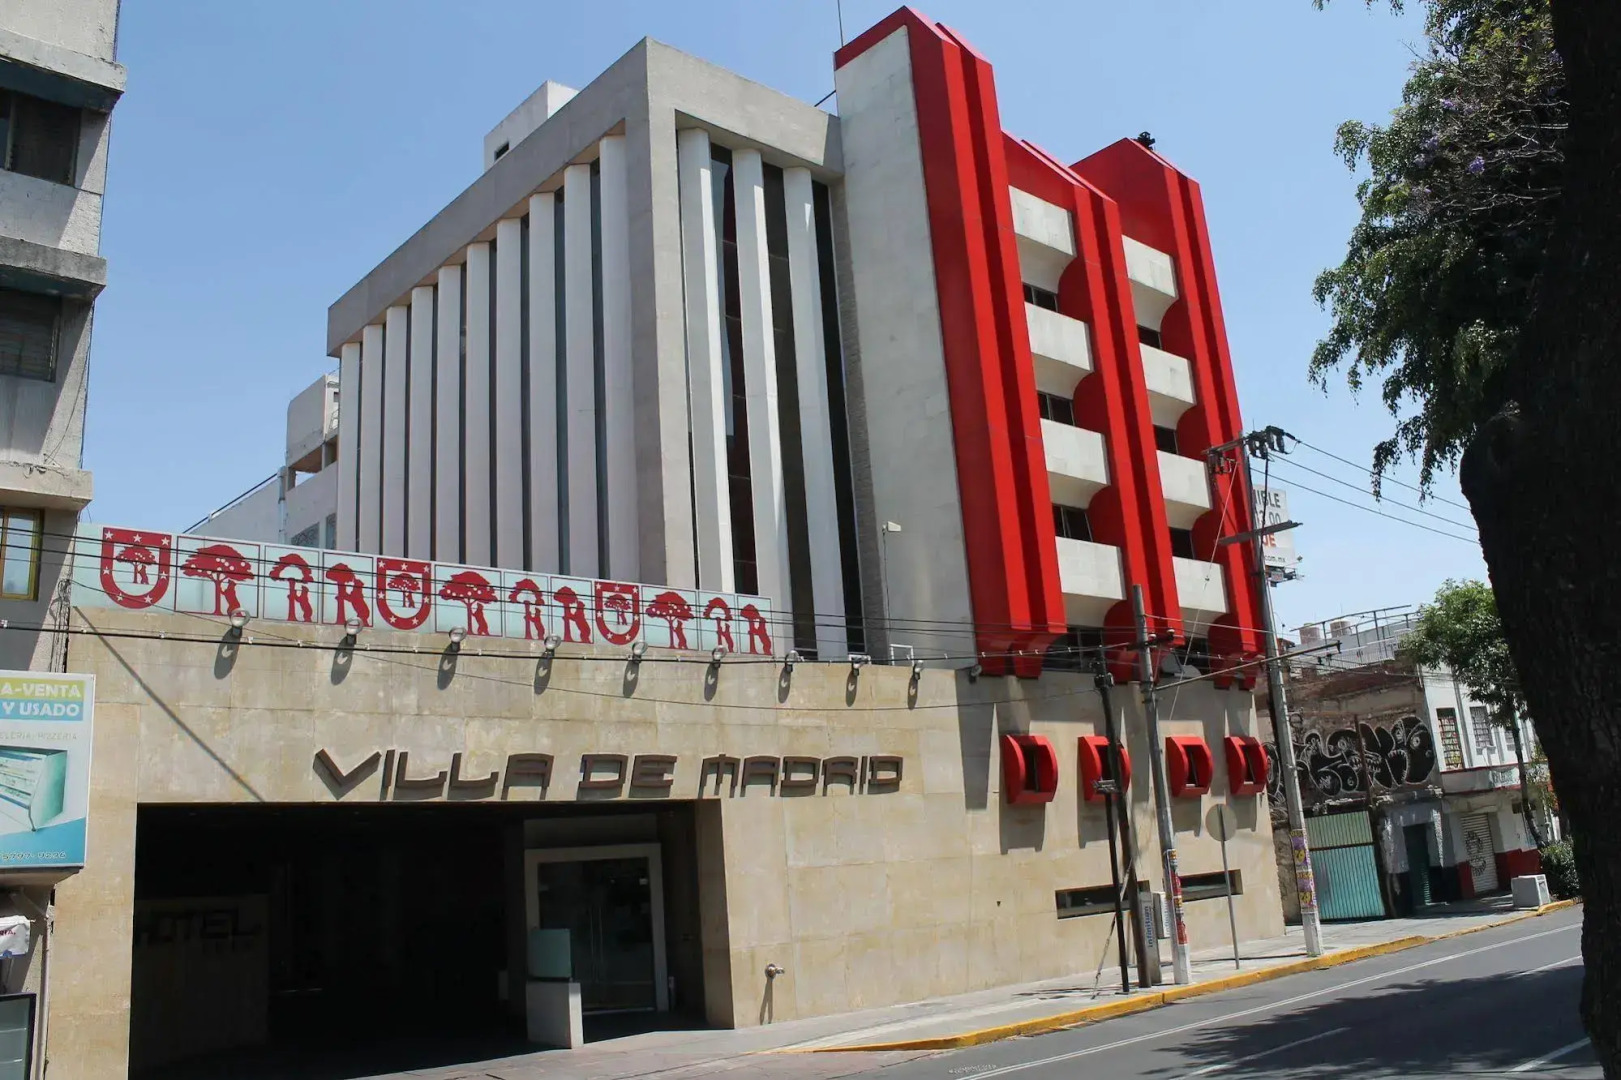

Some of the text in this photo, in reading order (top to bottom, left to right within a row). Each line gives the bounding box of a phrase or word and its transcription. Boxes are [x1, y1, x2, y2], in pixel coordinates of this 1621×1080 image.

[2, 701, 80, 717] Y USADO
[313, 749, 904, 793] VILLA DE MADRID
